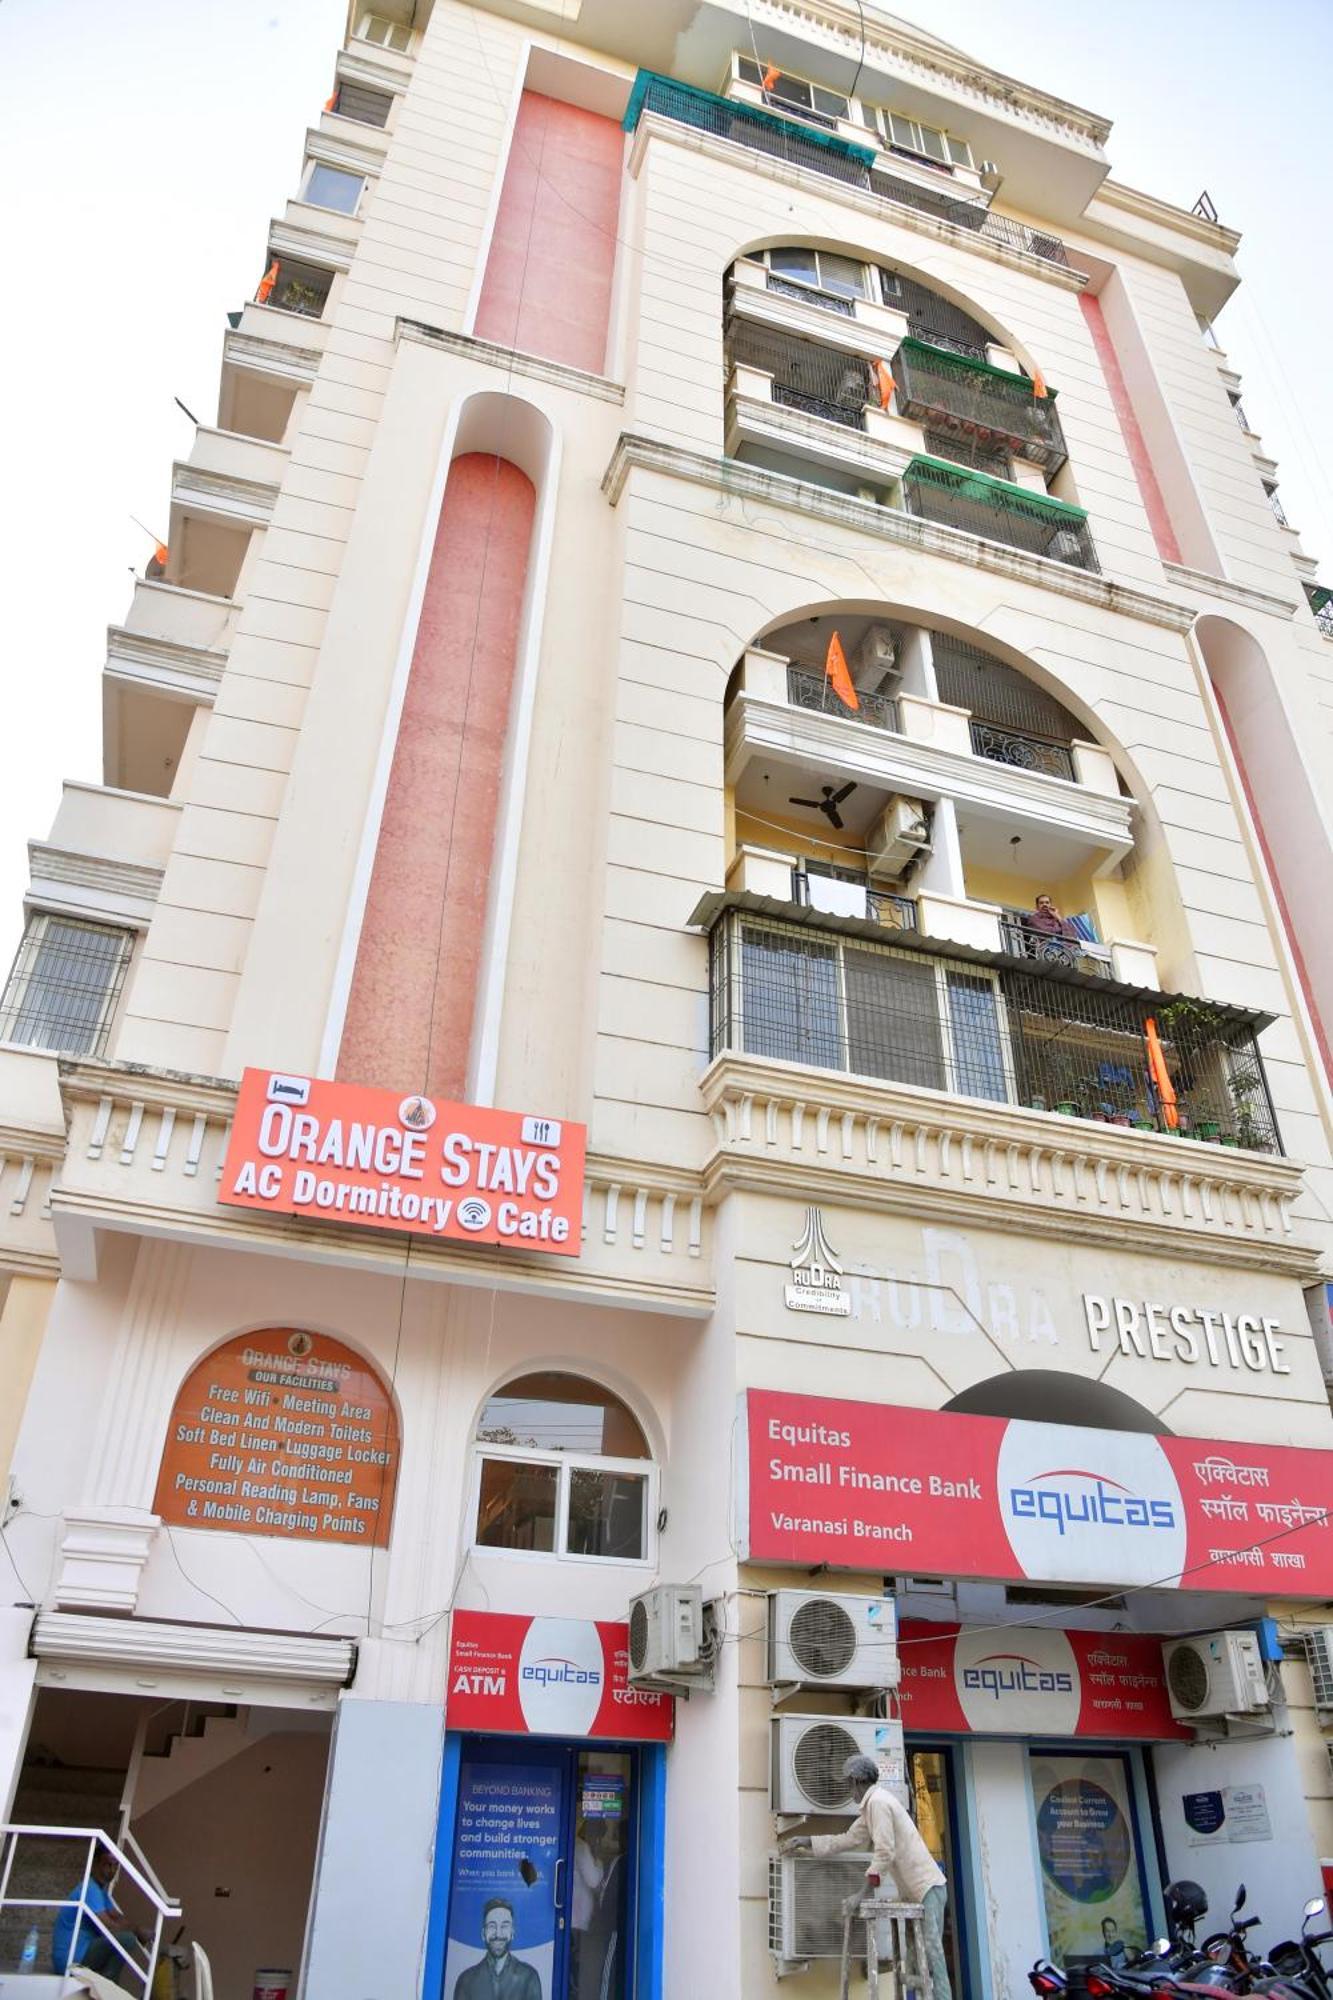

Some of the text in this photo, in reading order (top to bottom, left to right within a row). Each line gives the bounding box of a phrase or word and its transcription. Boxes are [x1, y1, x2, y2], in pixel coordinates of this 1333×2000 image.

[258, 1104, 561, 1199] ORANGE STAYS
[234, 1162, 569, 1241] AC Dormitory Cafe
[795, 1287, 841, 1300] Credibility
[1083, 1294, 1291, 1374] PRESTIGE
[242, 1349, 352, 1379] ORANGE STAYS
[255, 1371, 334, 1392] OUR FACILITIES
[209, 1384, 372, 1420] Free Wifi Meeting Area
[201, 1407, 372, 1443] Clean And Modern Toilets
[768, 1419, 851, 1448] Equitas
[177, 1425, 391, 1466] Soft Bed Linen Luggage Locker
[210, 1453, 353, 1485] Fully Air Conditioned
[769, 1459, 982, 1499] Small Finance Bank
[1192, 1456, 1270, 1487] एक्विटास
[176, 1473, 379, 1512] Personal Reading Lamp, Fans
[187, 1500, 366, 1534] & Mobile Charging Points
[1010, 1481, 1175, 1536] equitas
[1200, 1494, 1249, 1522] स्मॉल
[770, 1512, 913, 1542] Varanasi Branch
[1209, 1546, 1306, 1569] वाराणसी शाखा
[453, 1675, 506, 1696] ATM
[522, 1664, 600, 1687] equitas
[920, 1666, 947, 1678] Bank
[963, 1662, 1072, 1700] equitas
[612, 1686, 662, 1707] एटीएम
[472, 1784, 552, 1797] BEYOND BANKING
[462, 1801, 555, 1815] Your money works
[462, 1817, 541, 1830] to change lives
[459, 1849, 529, 1860] communities.
[460, 1833, 558, 1846] and build stronger
